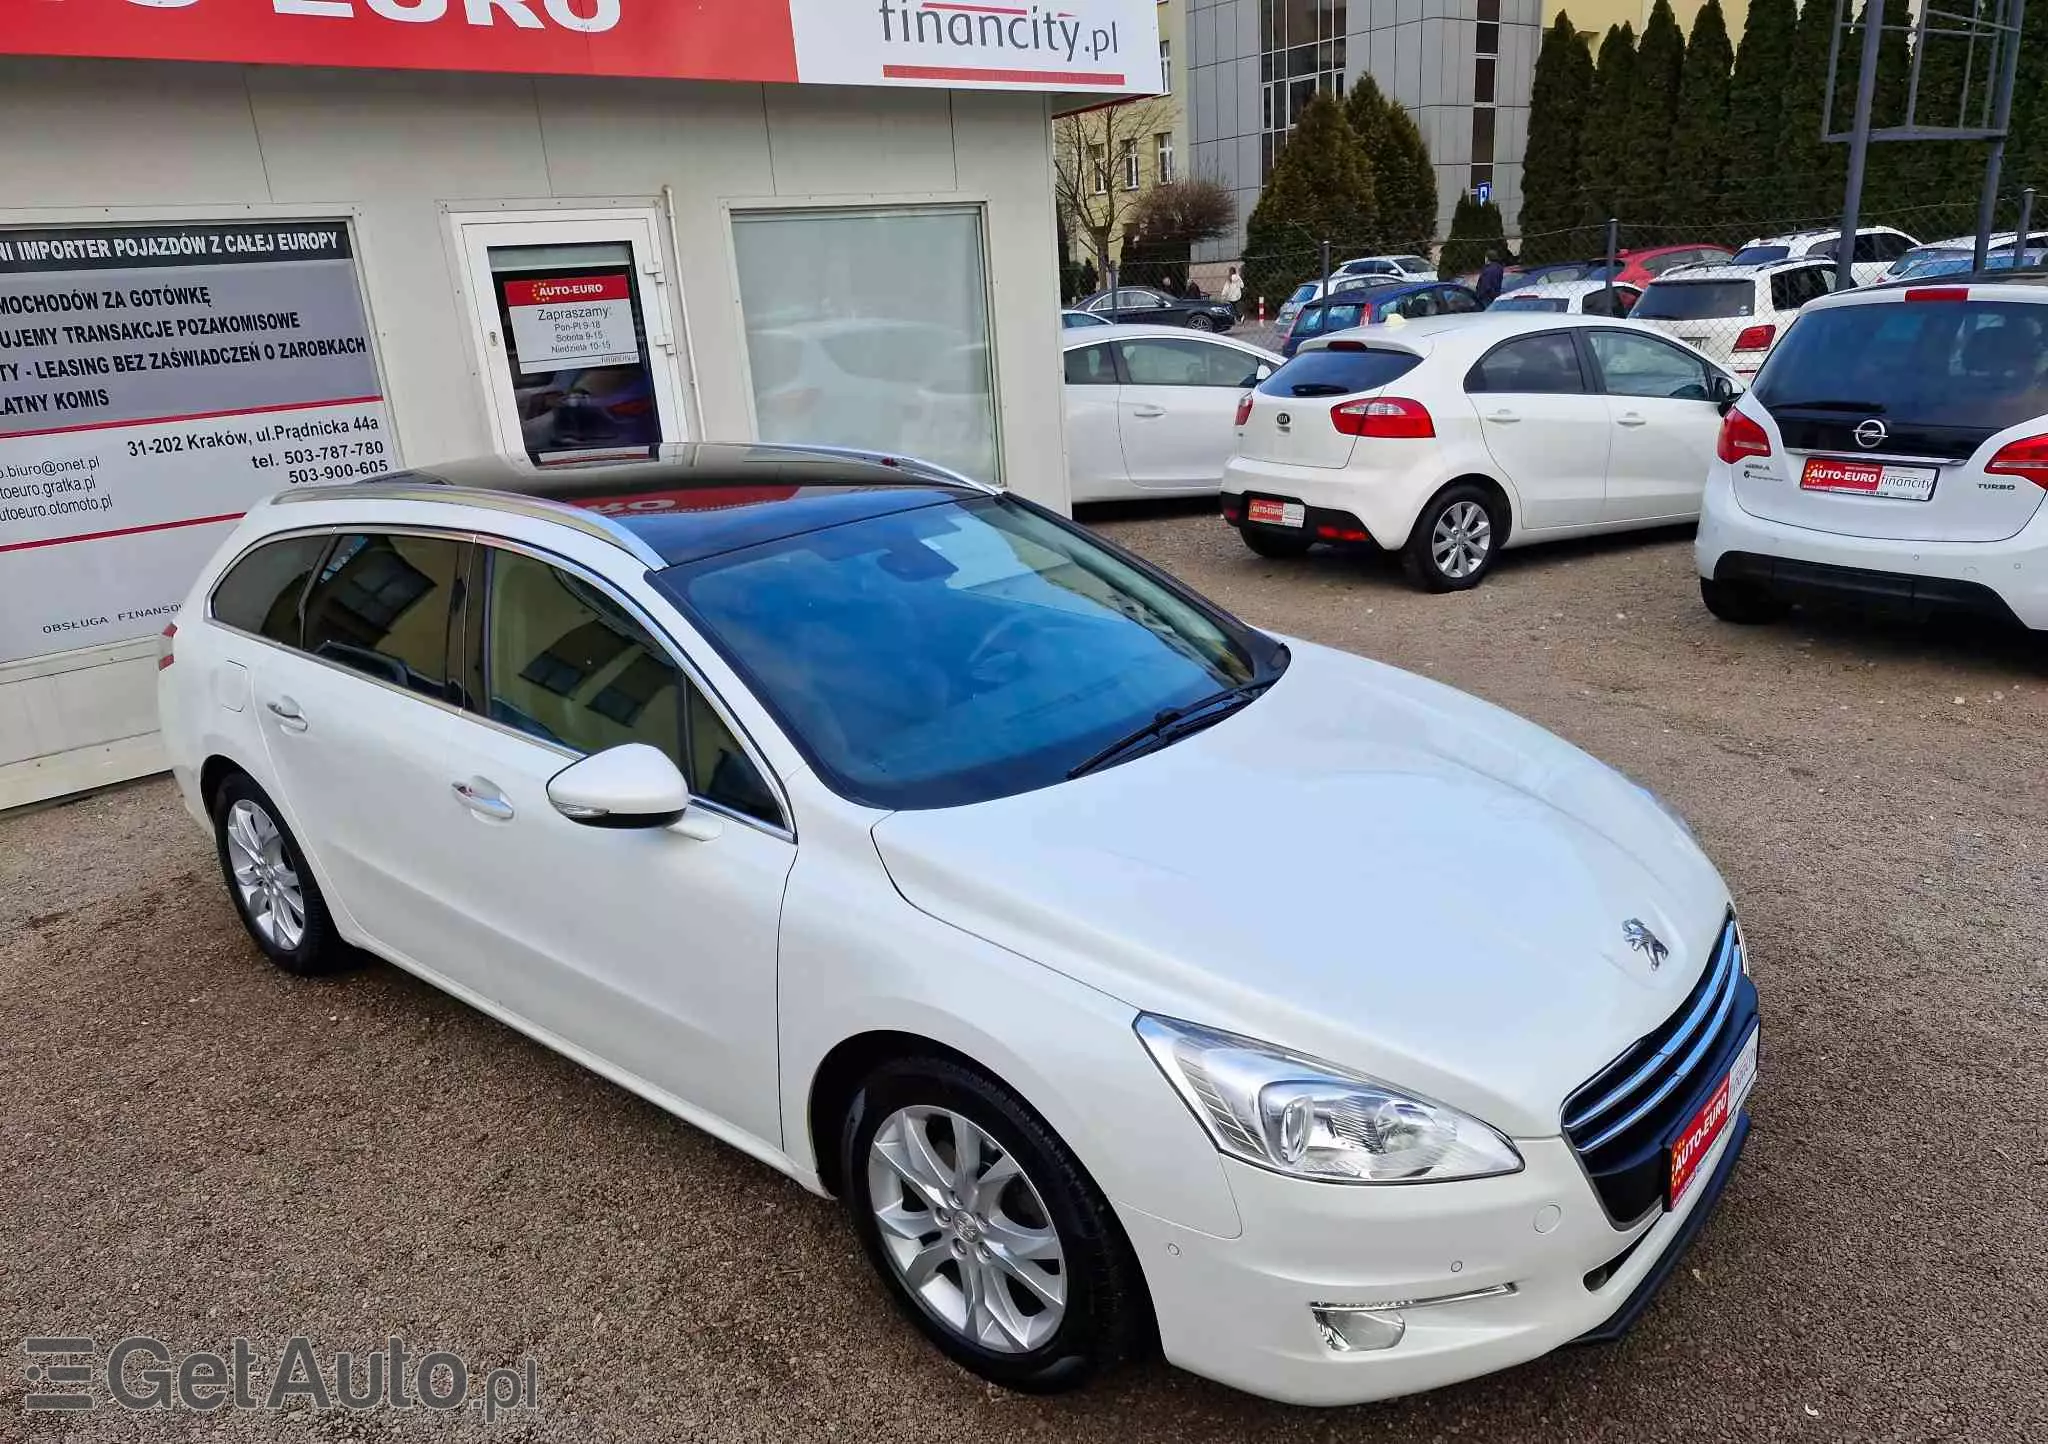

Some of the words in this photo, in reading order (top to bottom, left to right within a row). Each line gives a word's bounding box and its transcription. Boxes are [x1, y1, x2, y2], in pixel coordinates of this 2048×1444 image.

[879, 0, 1118, 62] financity.pl
[16, 239, 112, 261] IMPORTER
[113, 232, 206, 257] POJAZDÓW
[209, 235, 222, 254] Z
[224, 233, 275, 253] CAŁEJ
[278, 231, 337, 249] EUROPY
[0, 289, 99, 315] MOCHODÓW
[102, 290, 127, 309] ZA
[129, 284, 212, 307] GOTÓWKĘ
[539, 284, 604, 297] AUTO-EURO
[0, 327, 57, 349] UJEMY
[62, 320, 174, 344] TRANSAKCJE
[177, 312, 301, 336] POZAKOMISOWE
[35, 357, 109, 379] LEASING
[113, 354, 146, 373] BEZ
[149, 341, 261, 370] ZAŚWIADCZEŃ
[264, 344, 275, 360] O
[278, 337, 367, 359] ZAROBKACH
[53, 388, 109, 411] KOMIS
[127, 436, 183, 457] 31-202
[187, 430, 252, 450] Kraków,
[256, 419, 349, 442] ul.Prądnicka
[353, 415, 379, 431] 44a
[251, 453, 279, 469] tel.
[284, 440, 384, 465] 503-787-780
[289, 460, 388, 484] 503-900-605
[1810, 469, 1877, 483] AUTO-EURO
[1978, 483, 2016, 491] TURBO
[43, 616, 109, 634] OBSŁUGA
[118, 602, 184, 622] FINANSO
[1675, 1091, 1727, 1174] AUTO-EURO
